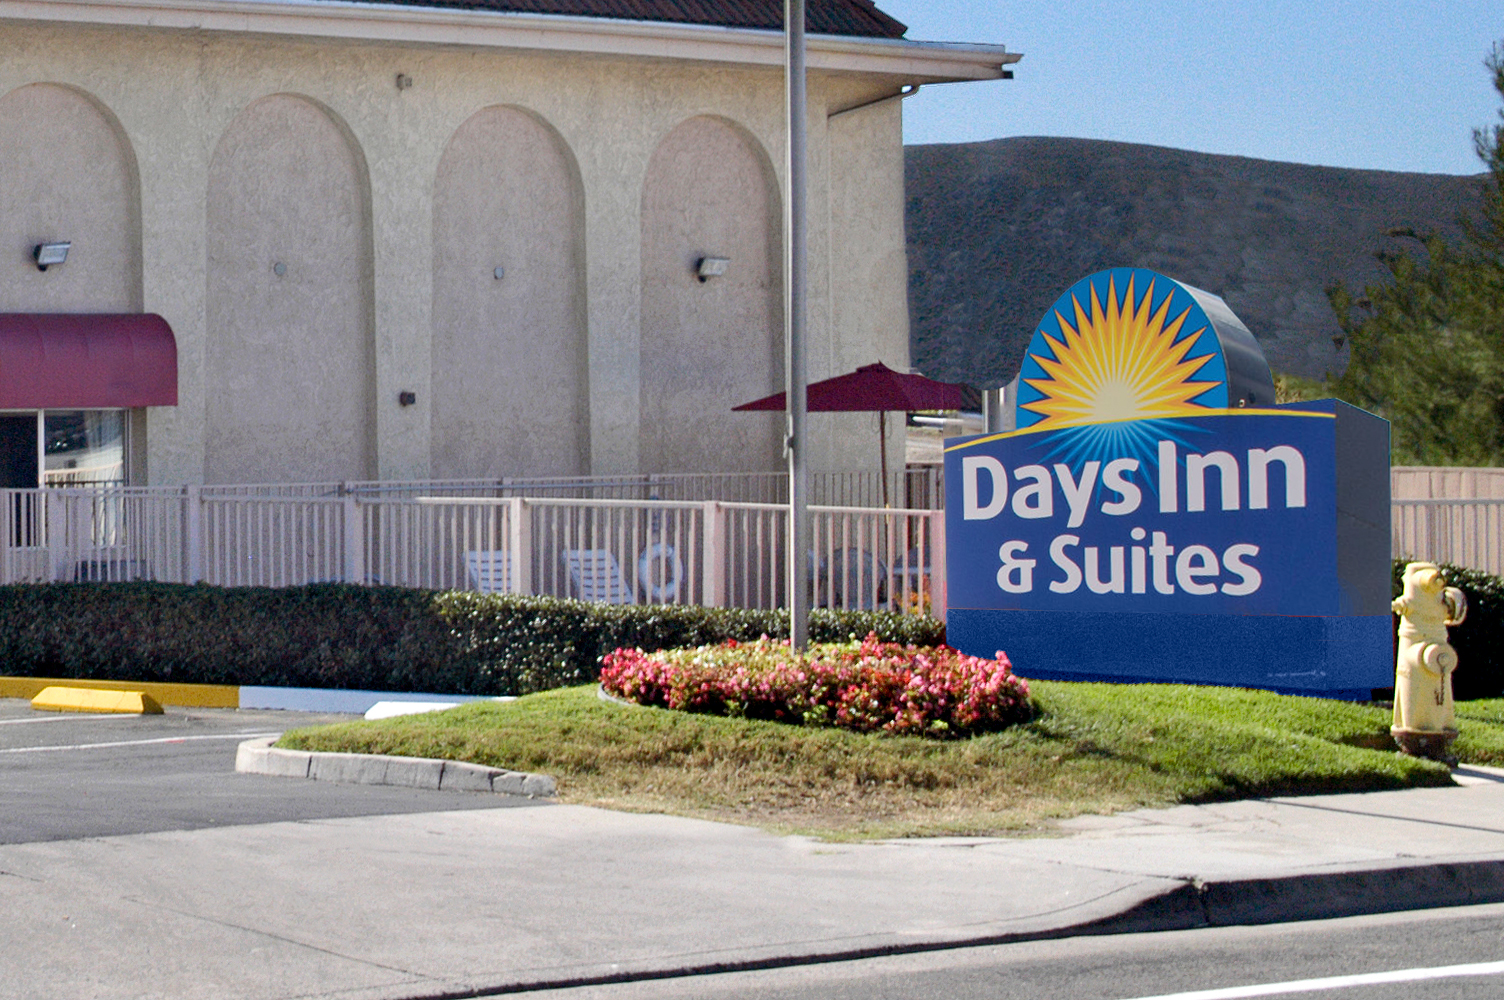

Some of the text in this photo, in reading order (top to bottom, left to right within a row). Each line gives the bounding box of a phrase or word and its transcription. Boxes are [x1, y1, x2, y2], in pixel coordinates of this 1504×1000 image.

[962, 440, 1307, 528] Days Inn
[996, 527, 1262, 596] & Suites
